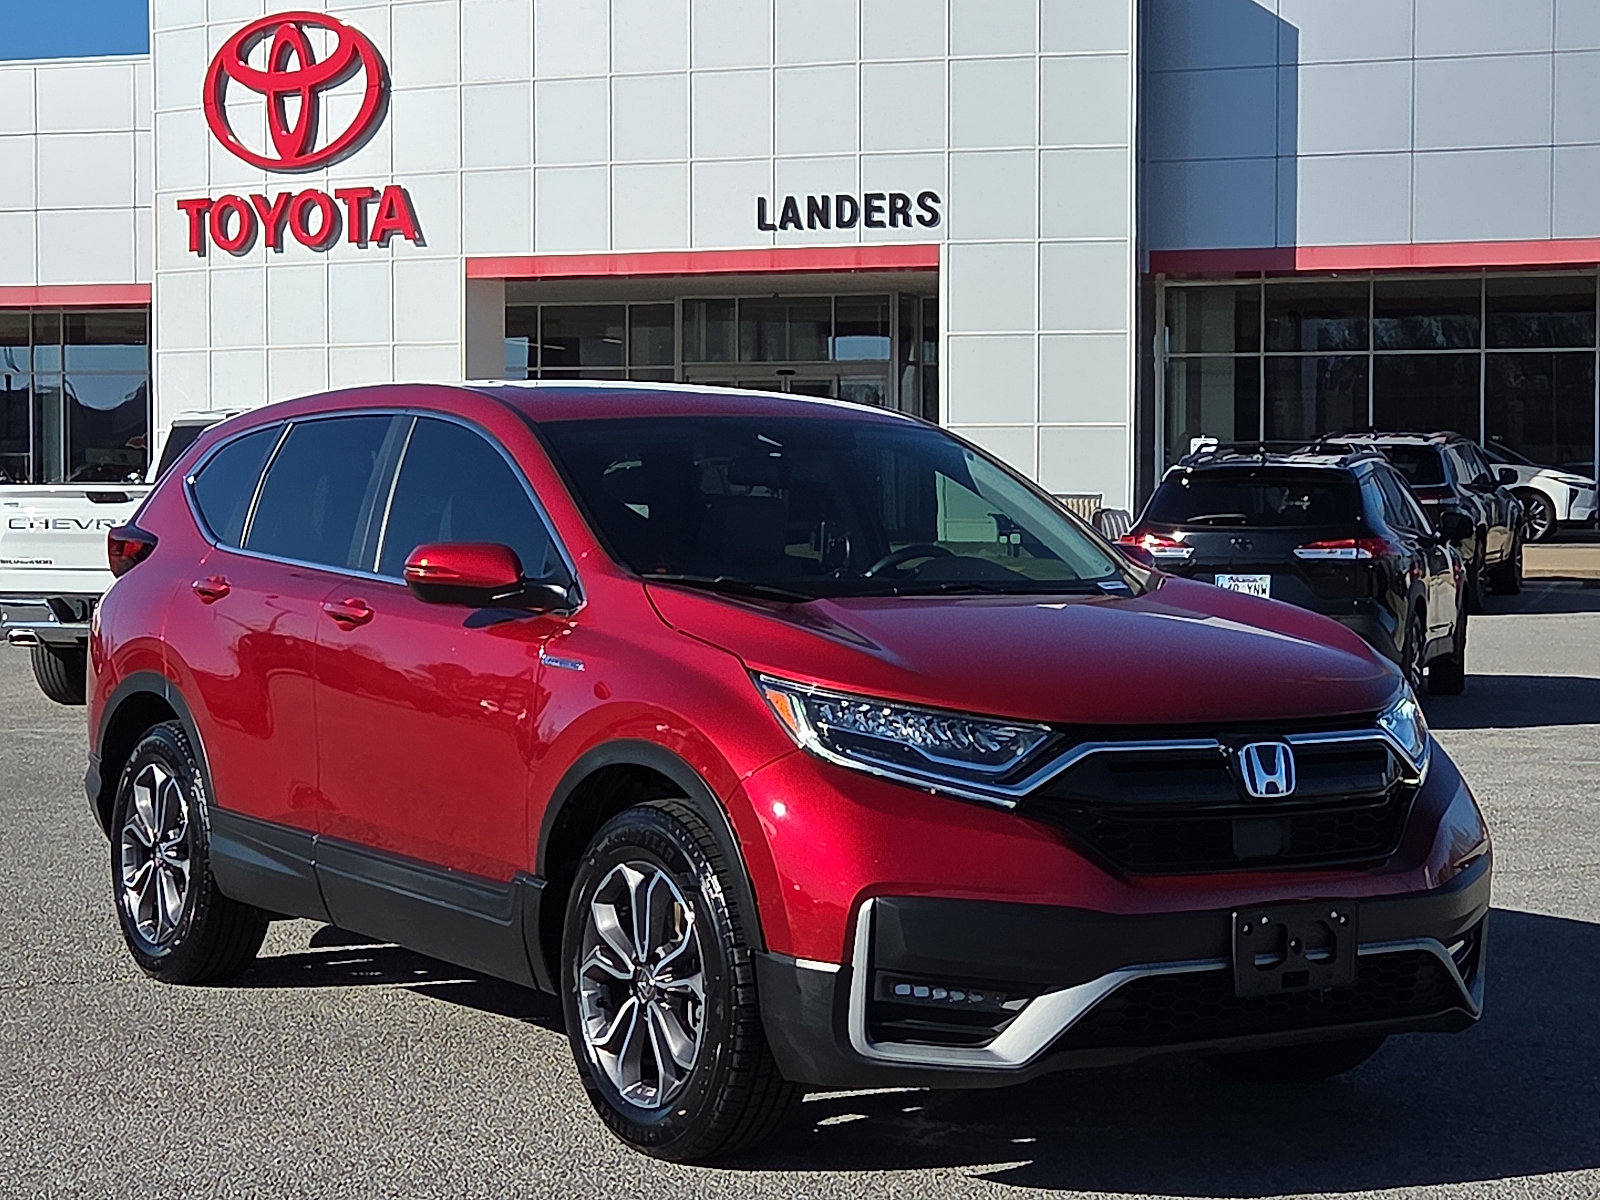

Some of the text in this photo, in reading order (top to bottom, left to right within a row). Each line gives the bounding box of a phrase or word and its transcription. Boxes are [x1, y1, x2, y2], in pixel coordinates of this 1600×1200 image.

[177, 185, 425, 256] TOYOTA
[757, 191, 941, 231] LANDERS
[9, 518, 127, 530] CHEVR
